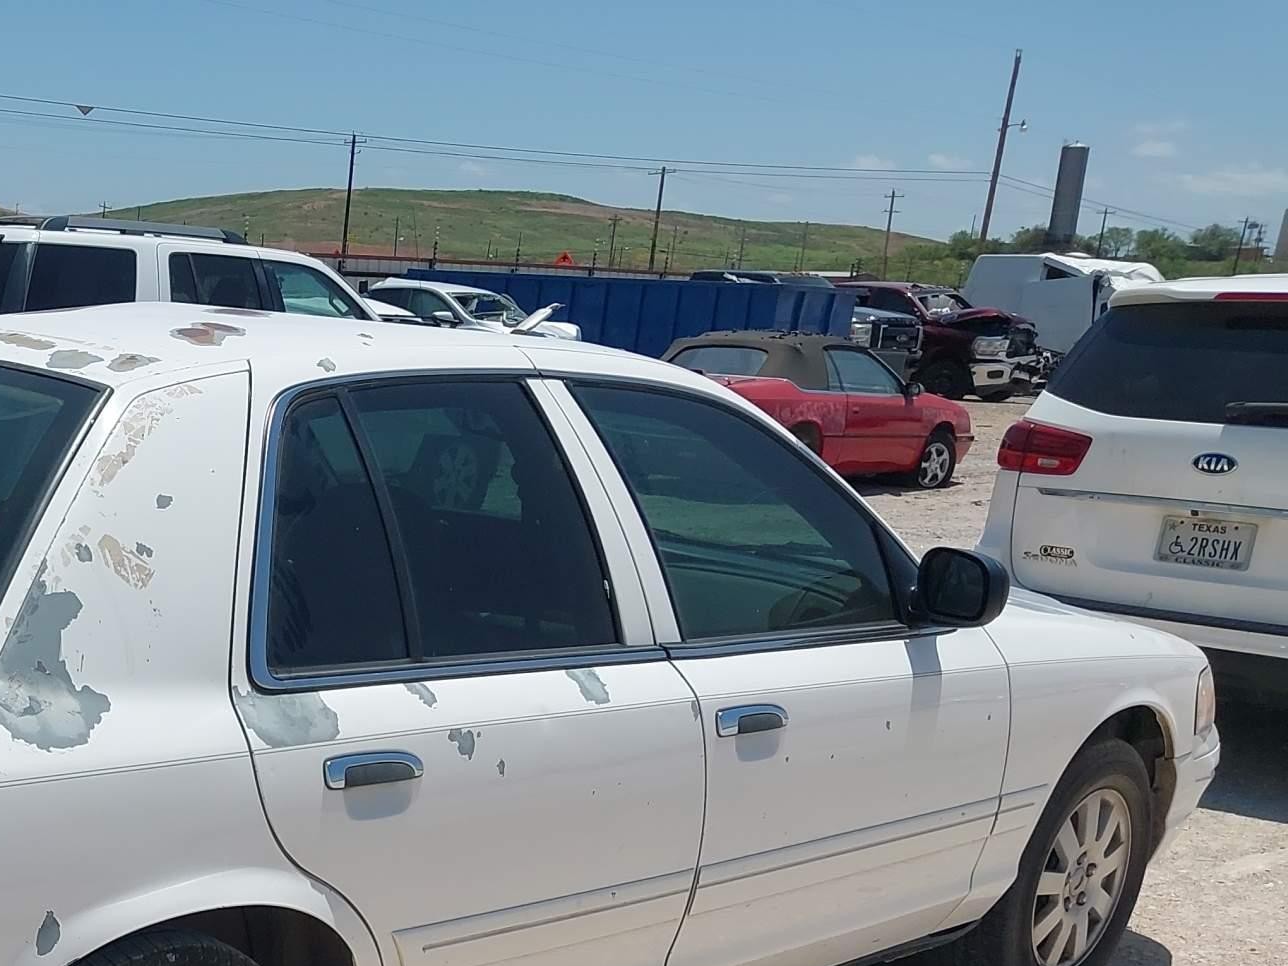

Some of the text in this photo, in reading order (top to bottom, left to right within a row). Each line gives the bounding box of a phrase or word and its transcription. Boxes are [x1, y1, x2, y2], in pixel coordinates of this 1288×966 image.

[1198, 456, 1229, 471] KIA
[1191, 523, 1227, 534] TEXAS
[1041, 545, 1074, 557] CLASSIC
[1187, 536, 1243, 561] 2RSHX
